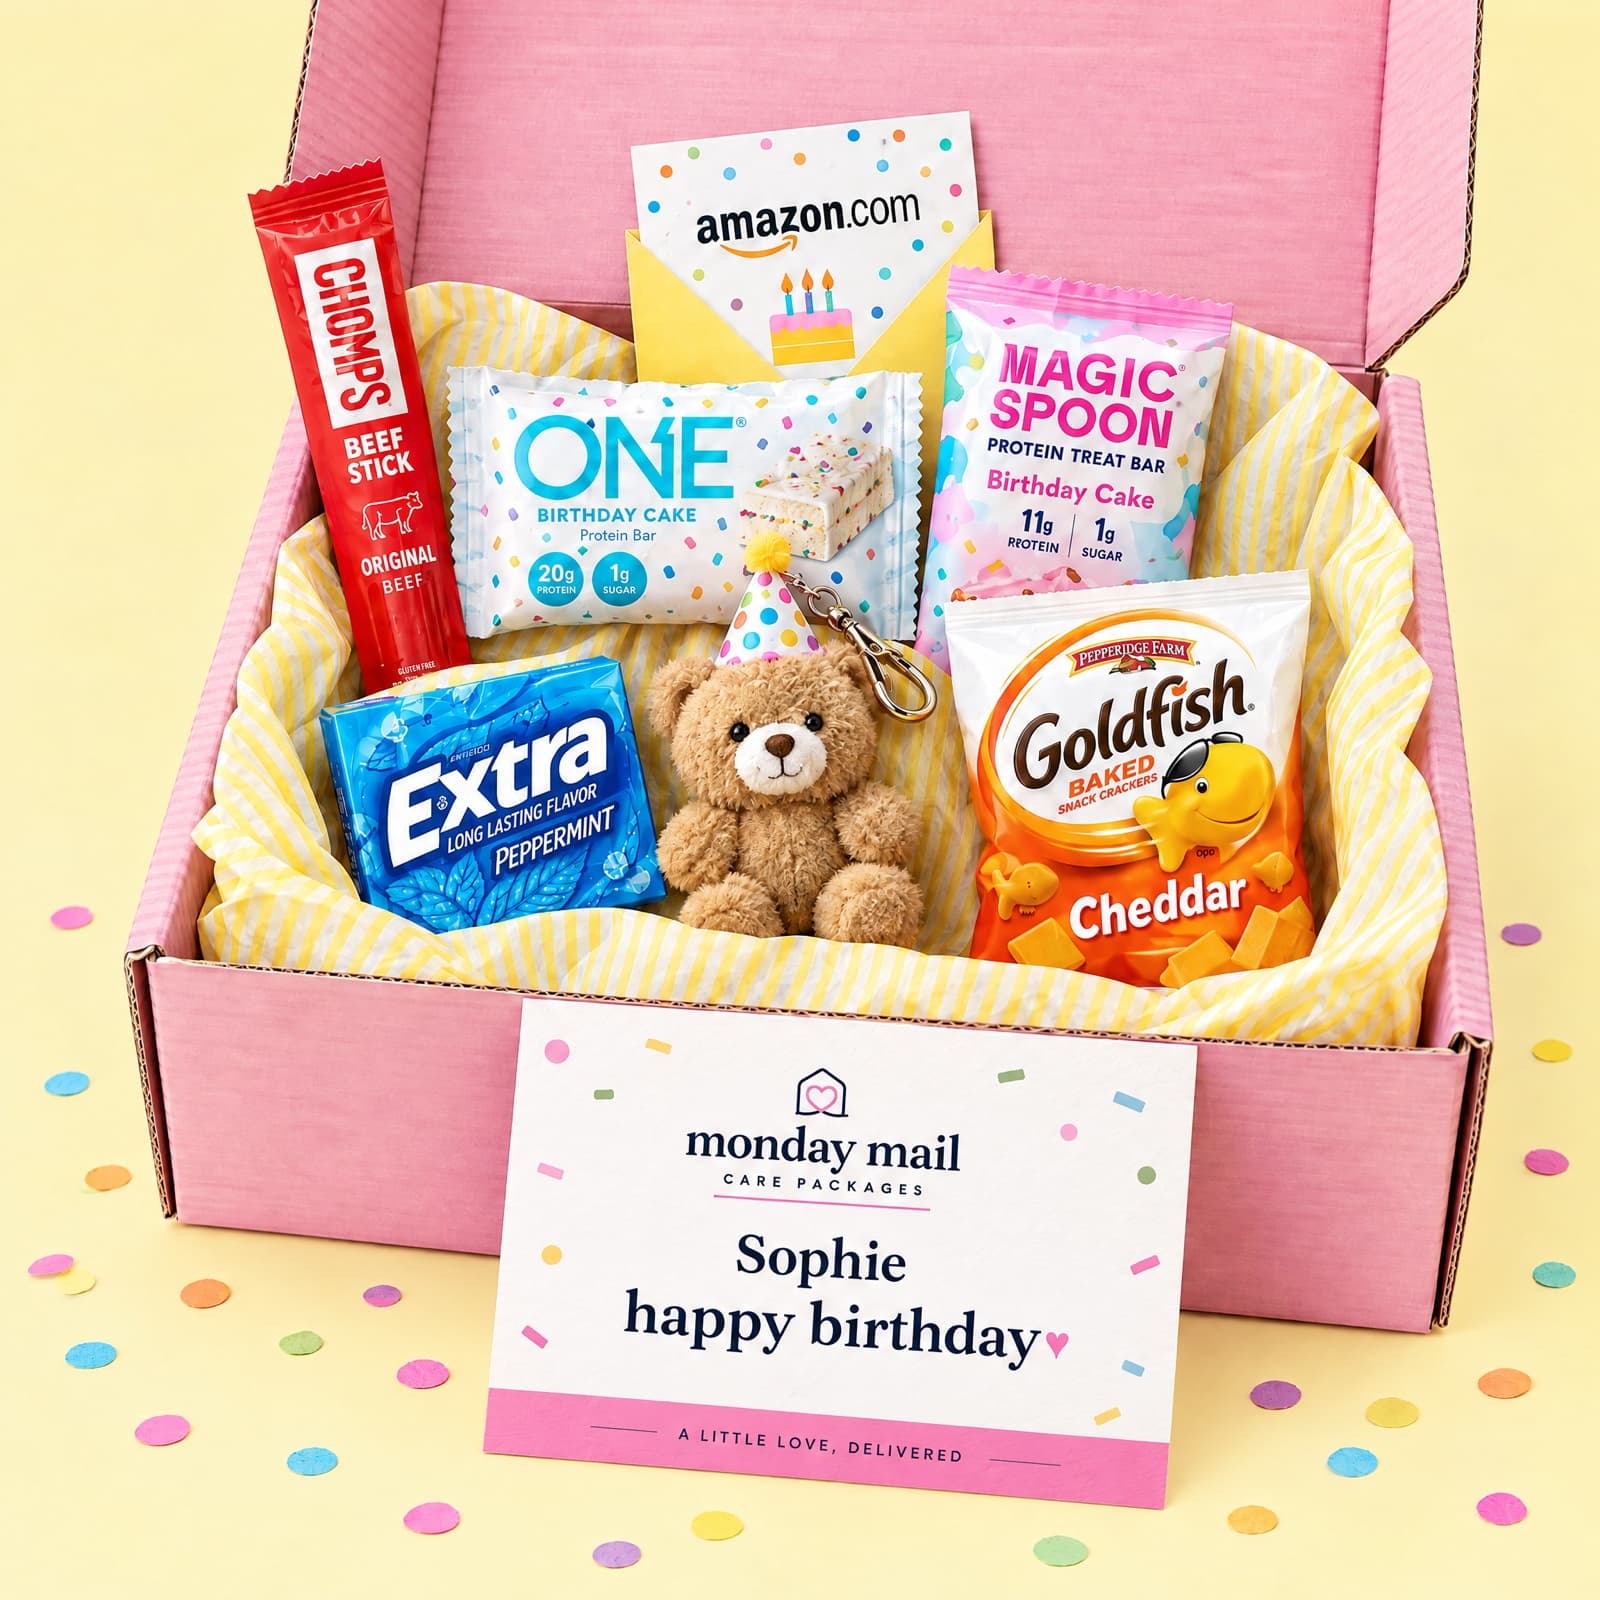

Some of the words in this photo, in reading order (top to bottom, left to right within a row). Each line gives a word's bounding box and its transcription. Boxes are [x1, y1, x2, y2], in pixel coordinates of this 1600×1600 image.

[696, 194, 921, 244] amazon.com
[314, 257, 392, 411] CHOMPS
[998, 343, 1178, 403] MAGIC
[990, 389, 1173, 449] SPOON
[344, 426, 404, 459] BEEF
[514, 414, 734, 500] ONE
[987, 437, 1064, 461] PROTEIN
[1071, 448, 1126, 469] TREAT
[1130, 456, 1165, 474] BAR
[347, 450, 415, 484] STICK
[987, 468, 1087, 506] Birthday
[1095, 483, 1155, 510] Cake
[537, 508, 637, 522] BIRTHDAY
[643, 508, 697, 522] CAKE
[1021, 508, 1054, 536] 11g
[1095, 517, 1115, 544] 1g
[580, 528, 628, 541] Protein
[633, 529, 656, 541] Bar
[361, 544, 437, 577] ORIGINAL
[1082, 547, 1123, 561] SUGAR
[382, 573, 424, 595] BEEF
[537, 586, 576, 594] PROTEIN
[538, 564, 574, 584] 20g
[603, 586, 636, 594] SUGAR
[609, 563, 630, 584] 1g
[397, 663, 421, 675] GLUTEN
[421, 660, 436, 670] FREE
[1079, 643, 1150, 666] PEPPERIDGE
[1152, 640, 1185, 656] FARM
[1013, 658, 1248, 789] Goldfish
[387, 717, 607, 868] Extra
[1058, 793, 1097, 815] SNACK
[1099, 773, 1158, 801] CRACKERS
[1069, 754, 1155, 798] BAKED
[447, 827, 484, 853] LONG
[487, 804, 542, 838] LASTING
[546, 783, 597, 816] FLAVOR
[495, 805, 615, 875] PEPPERMINT
[1069, 872, 1247, 940] Cheddar
[686, 1125, 857, 1174] monday
[866, 1133, 960, 1171] mail
[723, 1173, 782, 1188] CARE
[797, 1178, 923, 1196] PACKAGES
[736, 1233, 907, 1288] Sophie
[623, 1289, 796, 1354] happy
[809, 1301, 1042, 1371] birthday
[679, 1428, 689, 1441] A
[700, 1430, 766, 1447] LITTLE
[777, 1435, 837, 1455] LOVE,
[848, 1441, 962, 1463] DELIVERED
